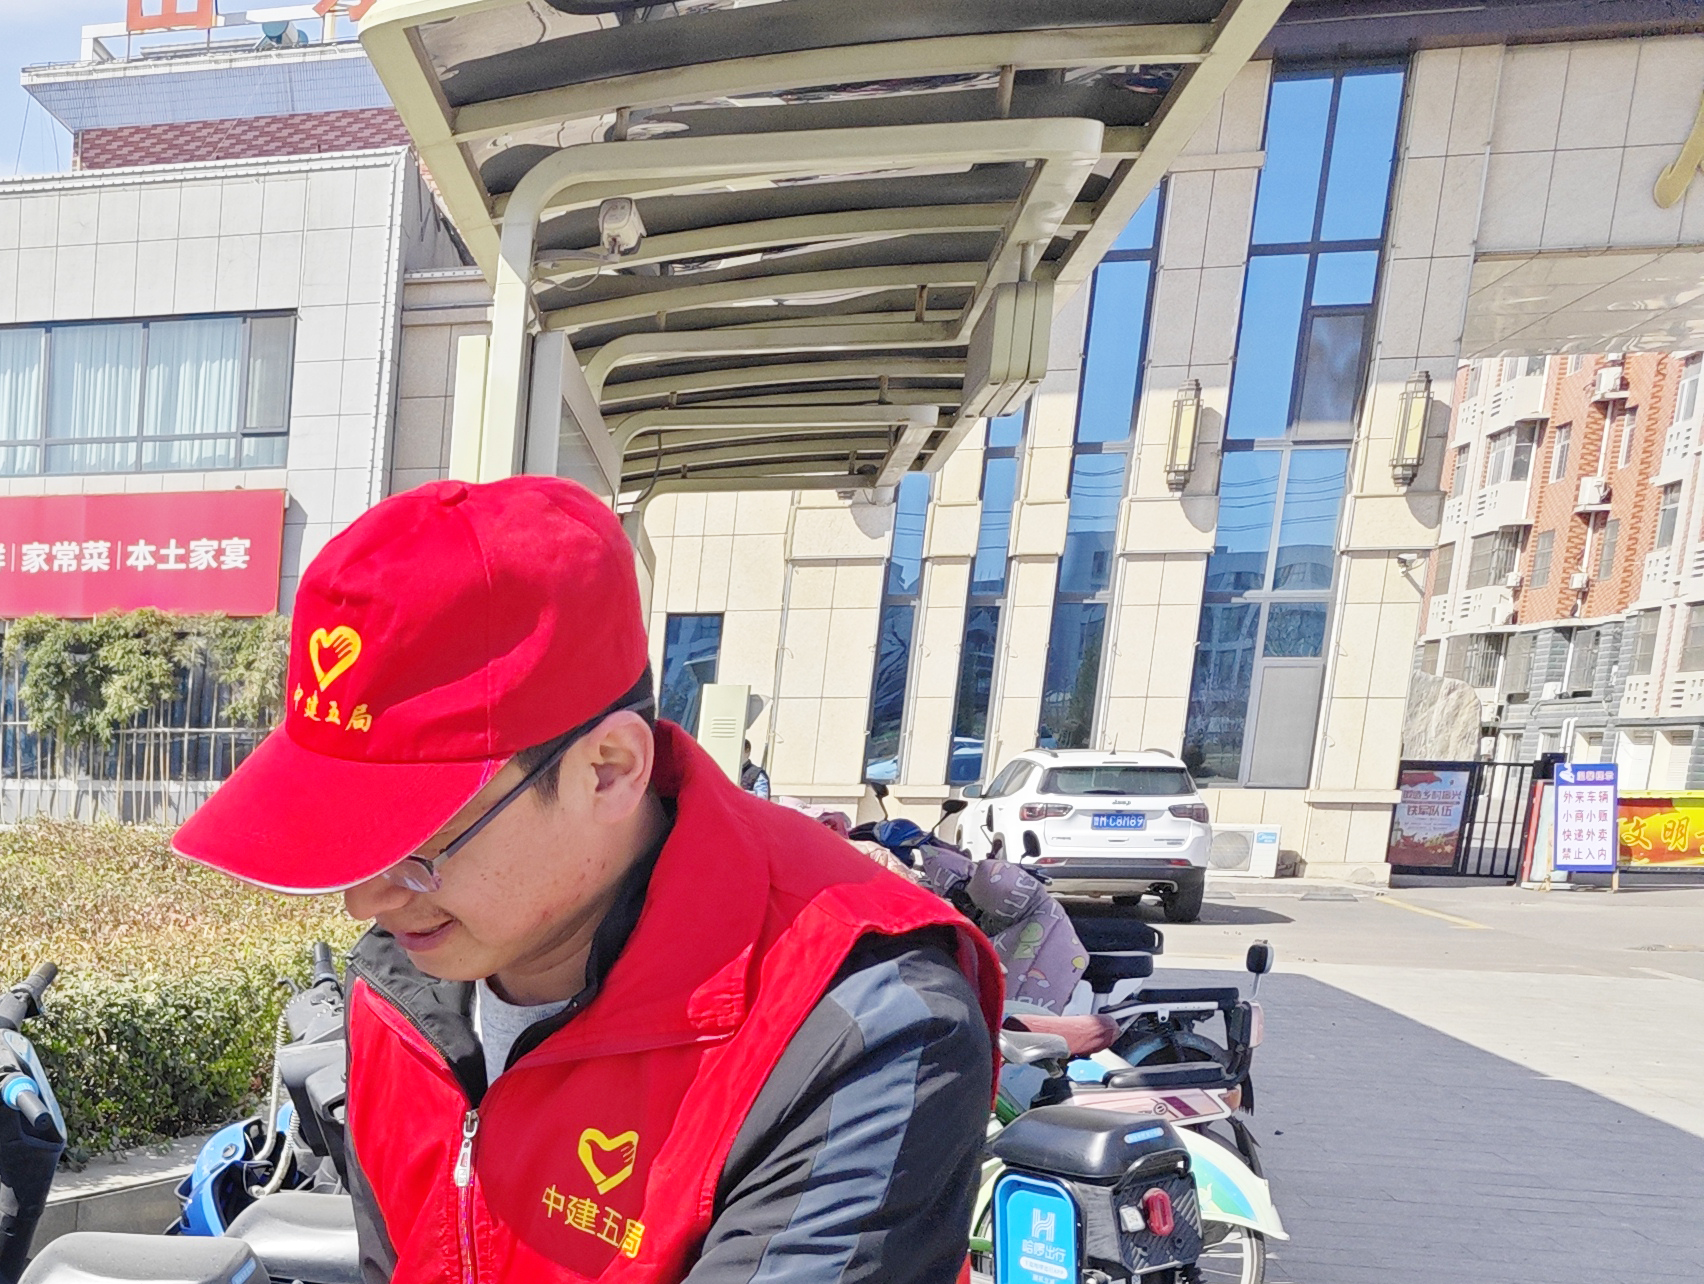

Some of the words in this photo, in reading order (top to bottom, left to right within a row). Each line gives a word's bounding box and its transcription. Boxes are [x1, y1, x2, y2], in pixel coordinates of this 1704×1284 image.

[20, 540, 112, 574] 家常菜
[125, 537, 252, 572] 本土家宴
[1562, 790, 1609, 804] 外来车辆
[1562, 809, 1609, 823] 小商小贩
[1562, 828, 1608, 842] 快递外卖
[1561, 847, 1608, 861] 禁止入内
[541, 1184, 646, 1259] 中建五局
